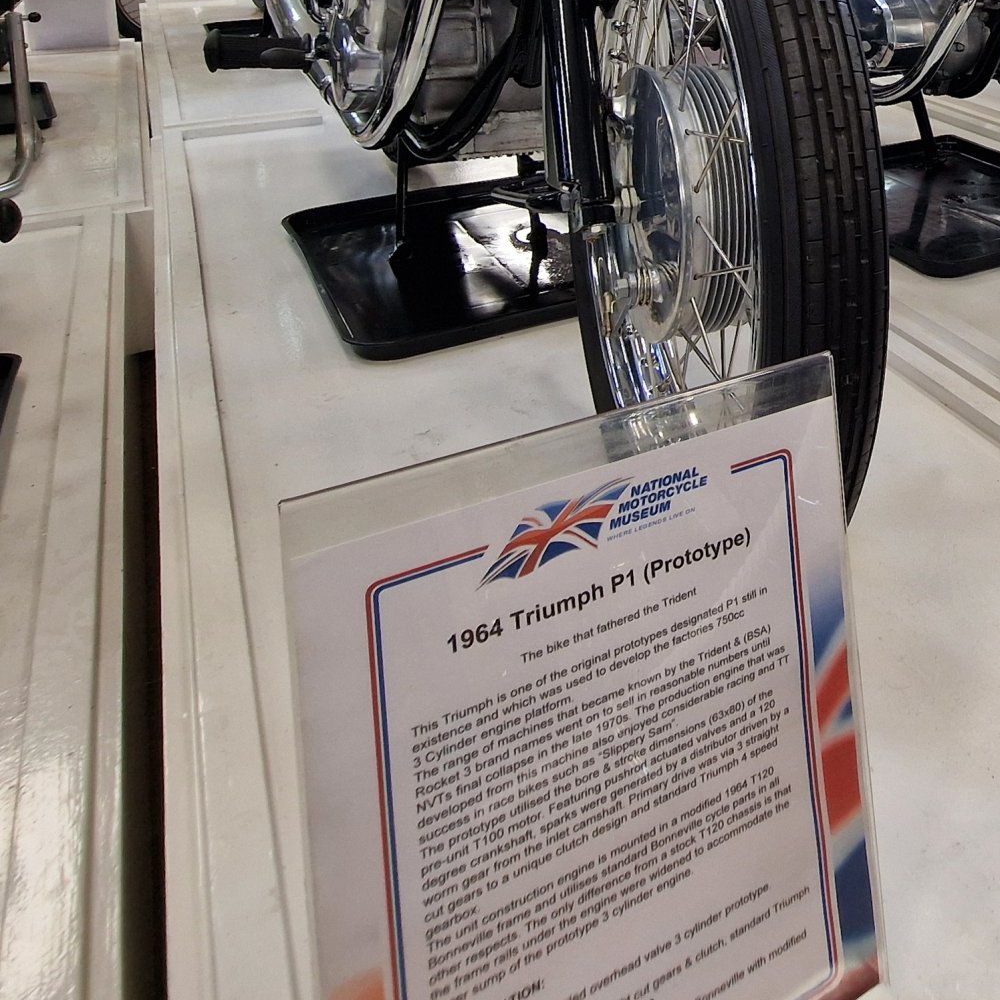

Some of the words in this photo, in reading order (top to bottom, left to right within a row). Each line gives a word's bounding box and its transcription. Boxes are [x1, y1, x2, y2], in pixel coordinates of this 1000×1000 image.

[607, 529, 633, 542] WHERE
[634, 517, 667, 533] LEGENDS
[668, 510, 684, 521] LIVE
[685, 506, 697, 515] ON
[609, 500, 671, 531] MUSEUM
[618, 475, 708, 515] MOTORCYCLE
[630, 467, 700, 498] NATIONAL
[446, 617, 504, 654] 1964
[509, 582, 605, 630] Triumph
[610, 568, 636, 595] P1
[643, 526, 752, 585] (Prototype)
[520, 649, 543, 664] The
[546, 638, 570, 655] bike
[572, 627, 594, 644] that
[596, 608, 641, 635] fathered
[642, 603, 660, 616] the
[661, 586, 697, 608] Trident
[411, 720, 439, 738] This
[441, 697, 494, 725] Triumph
[497, 692, 507, 704] is
[510, 682, 533, 699] one
[535, 673, 547, 688] of
[549, 668, 568, 682] the
[570, 648, 611, 674] original
[613, 628, 668, 658] prototypes
[670, 602, 724, 633] designated
[726, 596, 739, 610] P1
[741, 588, 757, 604] still
[759, 586, 768, 596] in
[411, 722, 473, 754] existence
[475, 707, 499, 728] and
[501, 694, 537, 716] which
[539, 684, 563, 701] was
[565, 669, 593, 691] used
[595, 667, 607, 678] to
[609, 649, 651, 672] develop
[653, 639, 670, 654] the
[671, 622, 714, 646] factories
[715, 609, 745, 627] 750cc
[413, 762, 440, 783] The
[442, 749, 479, 772] range
[482, 739, 495, 755] of
[497, 716, 554, 748] machines
[556, 705, 579, 723] that
[581, 687, 625, 713] became
[627, 672, 662, 693] known
[664, 665, 677, 678] by
[678, 658, 695, 671] the
[697, 640, 732, 662] Trident
[733, 636, 741, 647] &
[743, 623, 771, 645] (BSA)
[415, 770, 460, 799] Rocket
[463, 765, 472, 778] 3
[475, 748, 510, 773] brand
[513, 732, 553, 756] names
[555, 717, 584, 737] went
[585, 710, 600, 725] on
[602, 706, 614, 717] to
[616, 695, 635, 712] sell
[637, 692, 647, 702] in
[649, 667, 706, 697] reasonable
[707, 648, 749, 673] numbers
[751, 636, 771, 653] until
[413, 756, 422, 769] 3
[424, 734, 478, 763] Cylinder
[480, 716, 522, 740] engine
[524, 695, 574, 724] platform.
[416, 791, 453, 815] NVTs
[455, 775, 482, 797] final
[485, 755, 535, 783] collapse
[537, 749, 548, 760] in
[550, 739, 569, 754] the
[572, 728, 593, 745] late
[596, 713, 632, 734] 1970s.
[634, 702, 656, 717] The
[658, 678, 711, 710] production
[712, 663, 745, 683] engine
[747, 652, 765, 669] that
[766, 645, 786, 660] was
[417, 790, 483, 830] developed
[485, 779, 514, 799] from
[516, 768, 538, 785] this
[541, 745, 589, 774] machine
[592, 734, 615, 751] also
[617, 712, 659, 739] enjoyed
[661, 685, 724, 720] considerable
[726, 671, 756, 690] racing
[757, 660, 775, 677] and
[776, 653, 790, 667] TT
[419, 842, 445, 860] The
[448, 813, 506, 850] prototype
[509, 789, 551, 818] utilised
[553, 782, 572, 797] the
[574, 769, 600, 788] bore
[602, 762, 611, 774] &
[614, 747, 647, 769] stroke
[648, 719, 706, 752] dimensions
[708, 700, 745, 726] (63x80)
[747, 693, 757, 707] of
[758, 689, 773, 702] the
[418, 814, 471, 846] success
[473, 808, 485, 820] in
[488, 794, 515, 813] race
[518, 778, 549, 799] bikes
[552, 763, 579, 784] such
[582, 756, 596, 770] as
[429, 960, 462, 987] other
[524, 915, 548, 933] The
[550, 900, 575, 920] only
[577, 870, 632, 906] difference
[634, 855, 658, 875] from
[660, 850, 668, 861] a
[670, 834, 697, 856] stock
[698, 819, 725, 840] T120
[726, 800, 762, 826] chassis
[764, 795, 772, 806] is
[774, 784, 792, 801] that
[588, 957, 642, 994] overhead
[643, 940, 672, 964] valve
[673, 931, 682, 946] 3
[683, 910, 723, 942] cylinder
